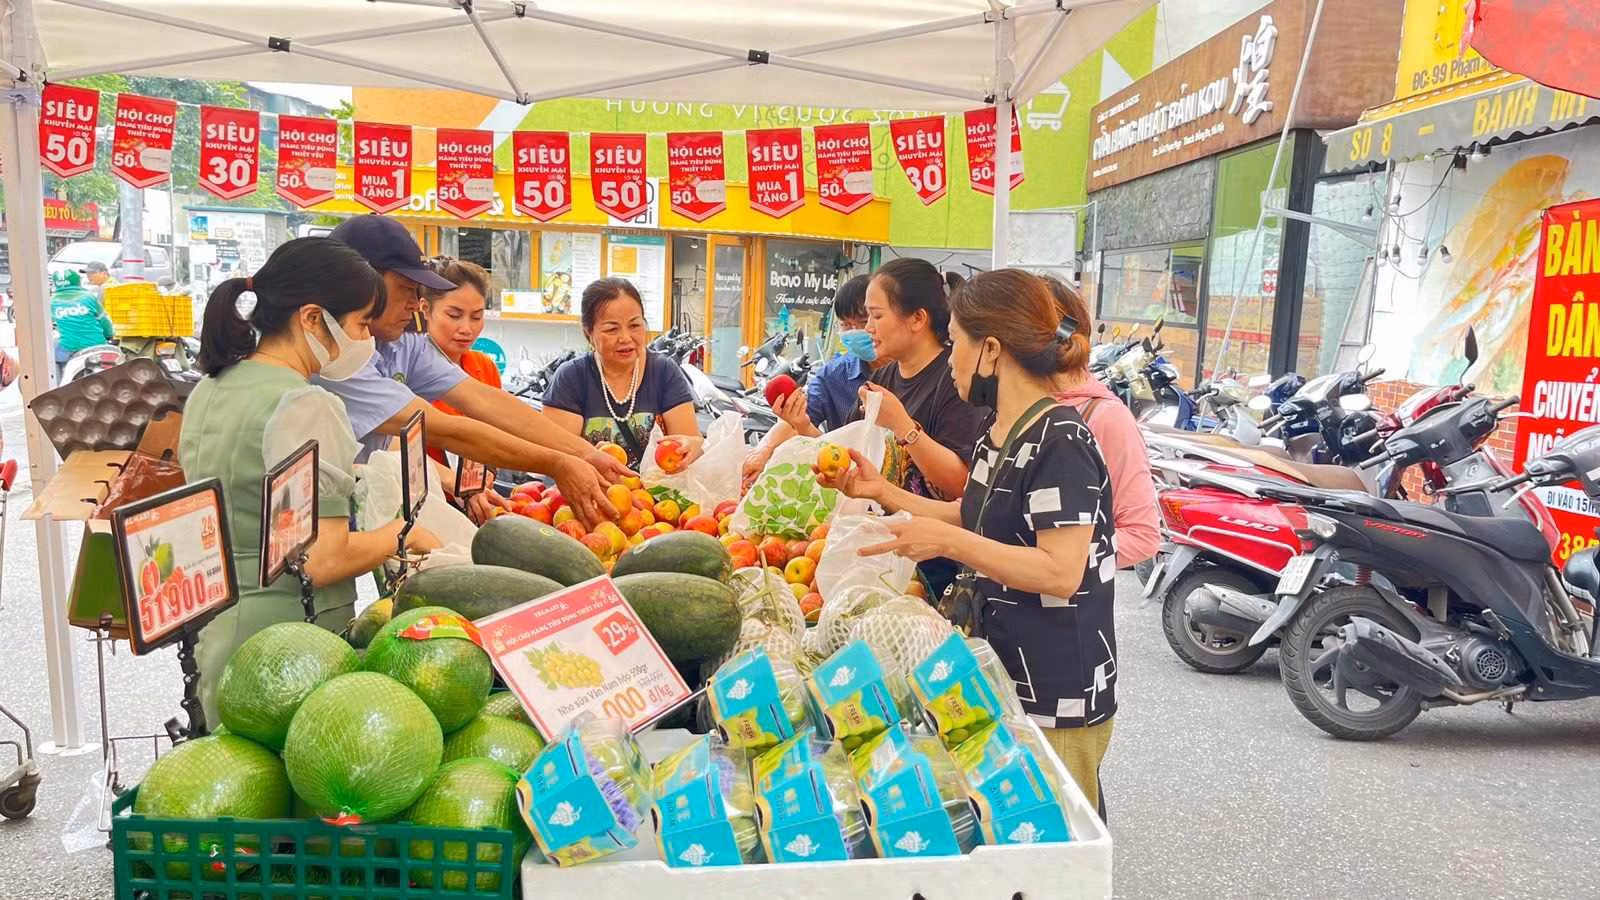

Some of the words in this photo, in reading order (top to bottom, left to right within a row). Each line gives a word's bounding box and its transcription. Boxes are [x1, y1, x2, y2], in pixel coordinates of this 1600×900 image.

[1432, 62, 1448, 85] 99
[46, 98, 93, 122] SIÊU
[117, 108, 143, 122] HỘI
[144, 112, 174, 127] CHỢ
[1137, 101, 1169, 143] NHẬT
[1168, 82, 1200, 130] BẢN
[1198, 76, 1229, 117] KOU
[206, 121, 255, 144] SIÊU
[280, 128, 305, 143] HỘI
[307, 132, 336, 146] CHỢ
[967, 122, 991, 135] HỘI
[359, 136, 408, 158] SIÊU
[438, 141, 463, 155] HỘI
[465, 143, 492, 156] CHỢ
[817, 137, 840, 151] HỘI
[842, 135, 869, 149] CHỢ
[896, 129, 942, 152] SIÊU
[1381, 122, 1393, 157] 8
[517, 144, 566, 164] SIÊU
[594, 144, 642, 165] SIÊU
[670, 146, 693, 160] HỘI
[695, 144, 722, 158] CHỢ
[751, 141, 798, 163] SIÊU
[361, 175, 388, 186] MUA
[391, 169, 405, 199] 1
[361, 185, 394, 200] TẶNG
[756, 181, 782, 192] MUA
[784, 171, 799, 202] 1
[756, 191, 789, 205] TẶNG
[769, 270, 801, 288] Bravo
[804, 272, 821, 293] My
[55, 304, 89, 319] Grab
[1218, 515, 1280, 532] LEAD
